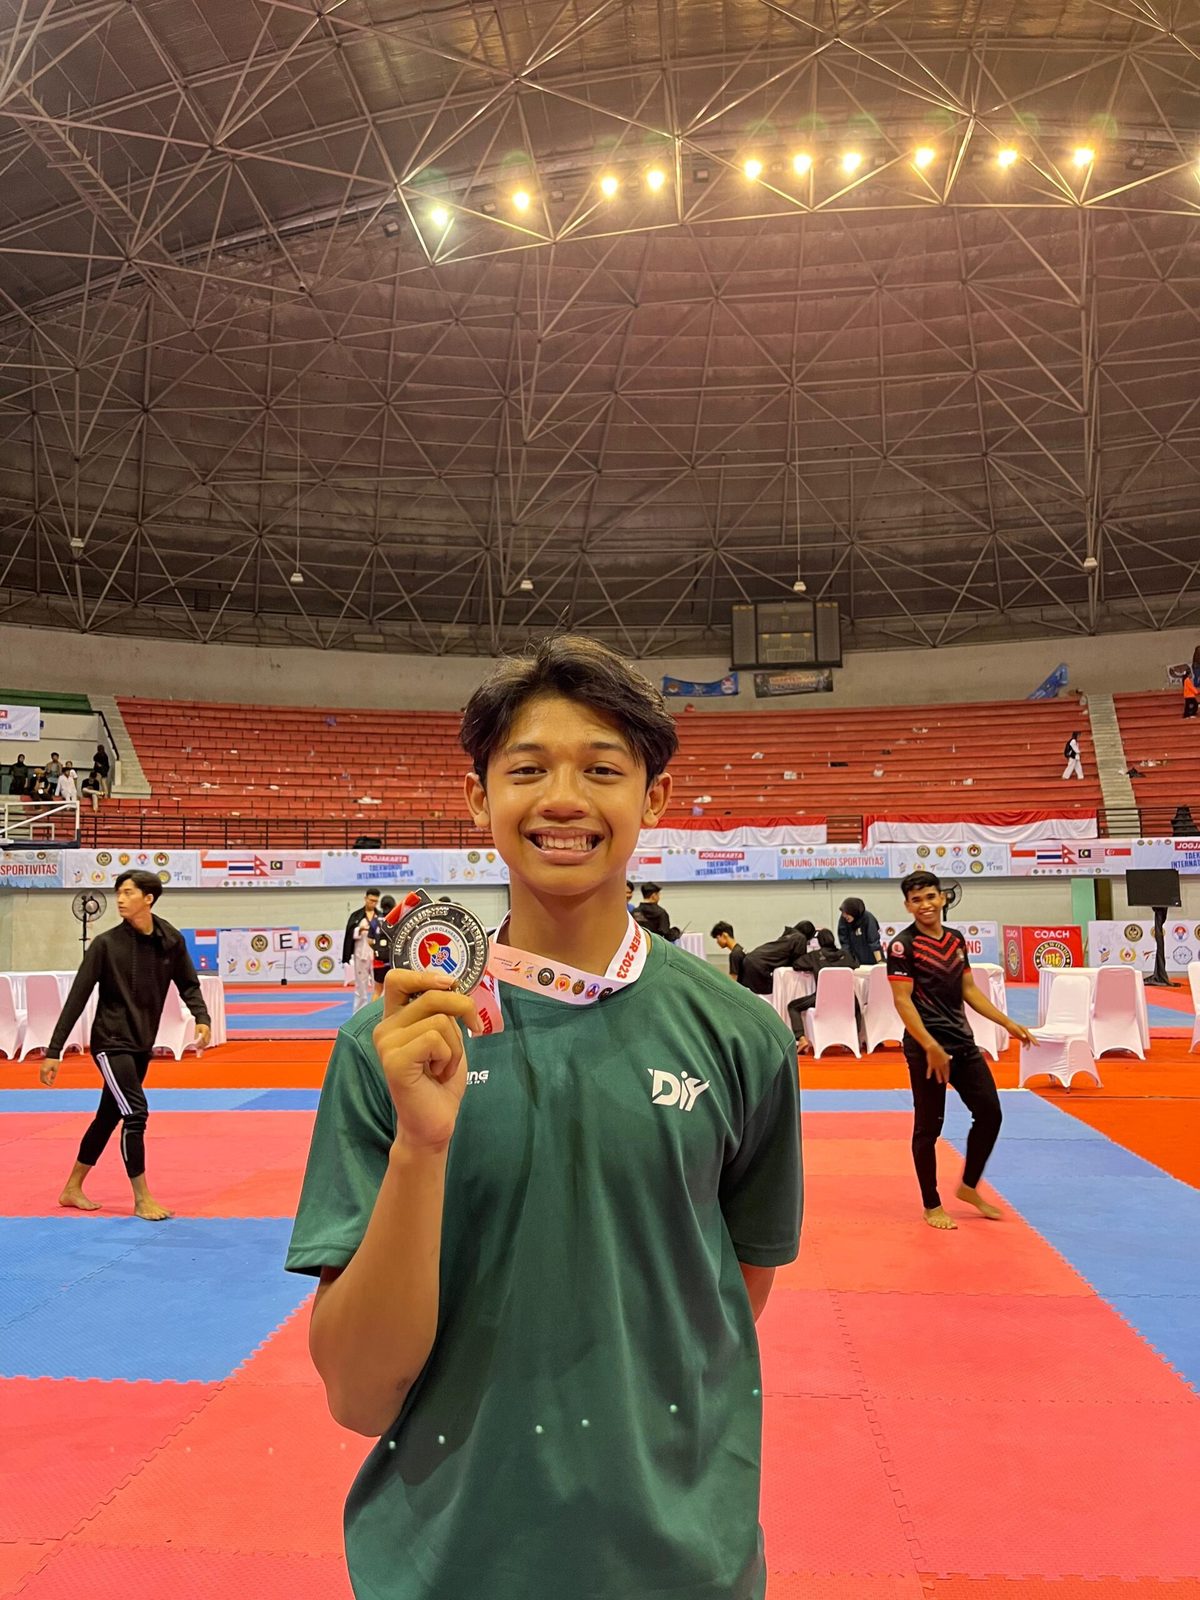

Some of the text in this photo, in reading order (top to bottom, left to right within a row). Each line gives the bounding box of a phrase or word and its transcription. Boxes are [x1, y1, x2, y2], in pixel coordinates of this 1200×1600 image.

[362, 855, 408, 863] JOGJAKARTA
[783, 855, 884, 868] JUNJUNG TINGGI SPORTIVITAS
[0, 864, 57, 876] SPORTIVITAS
[357, 869, 414, 880] INTERNATIONAL OPEN
[696, 865, 749, 875] INTERNATIONAL OPEN
[1034, 930, 1070, 939] COACH
[279, 933, 293, 950] E
[616, 951, 635, 979] 2023
